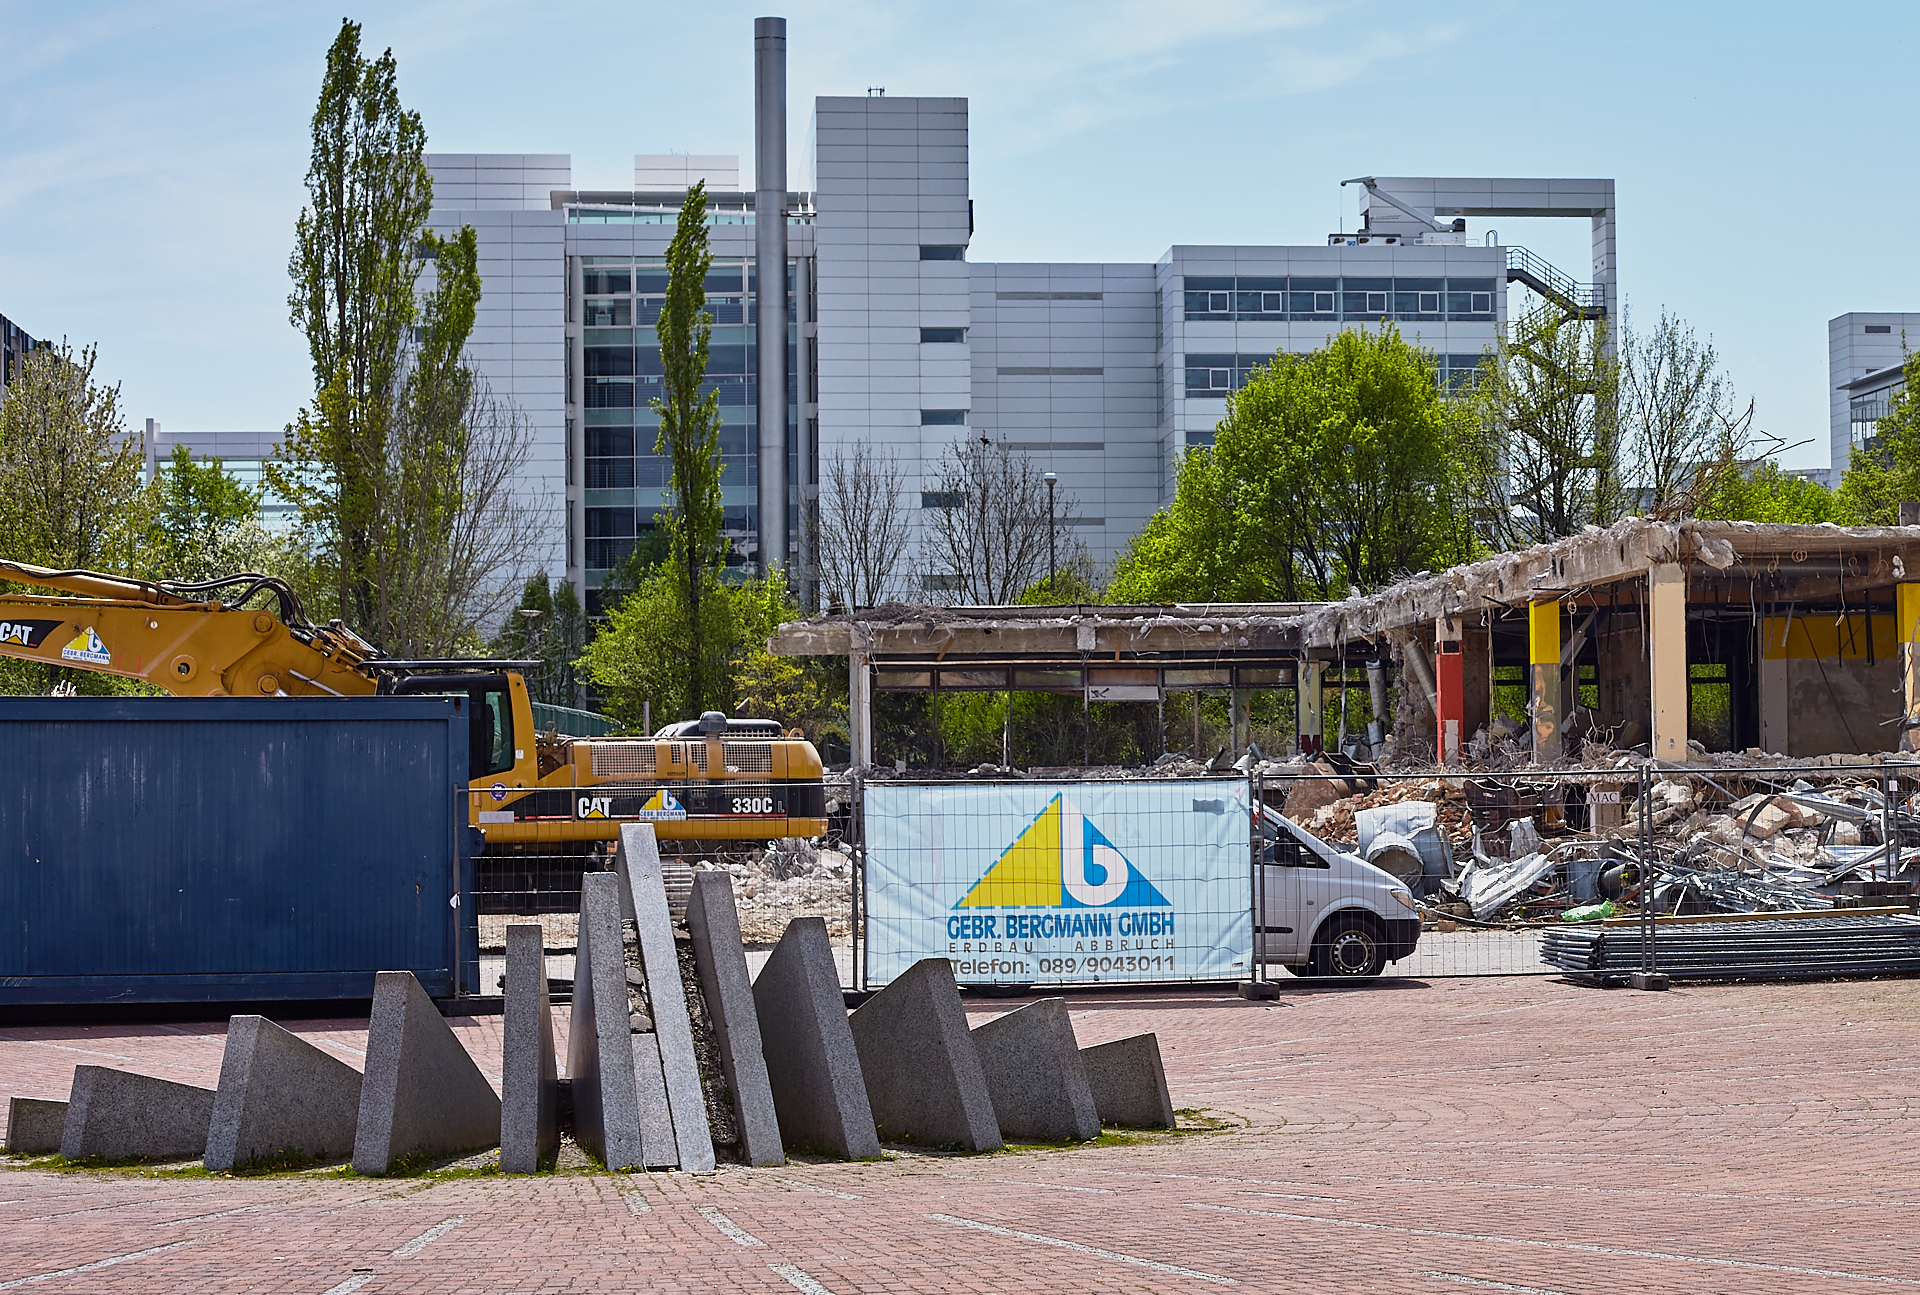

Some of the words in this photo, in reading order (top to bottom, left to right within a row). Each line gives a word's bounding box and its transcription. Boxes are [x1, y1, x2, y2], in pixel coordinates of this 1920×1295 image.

[0, 622, 33, 646] CAT
[63, 649, 79, 657] GEBR.
[80, 651, 110, 661] BERGMANN
[732, 797, 773, 813] 330C
[1590, 792, 1617, 802] MAC
[578, 797, 612, 819] CAT
[947, 913, 1002, 940] GEBR.
[1006, 912, 1112, 939] BERGMANN
[1118, 911, 1174, 937] GMBH
[949, 941, 1033, 953] ERDBAU
[1075, 938, 1174, 951] ABBRUCH
[951, 957, 1031, 975] Telefon:
[1038, 955, 1174, 975] 089/9043011
